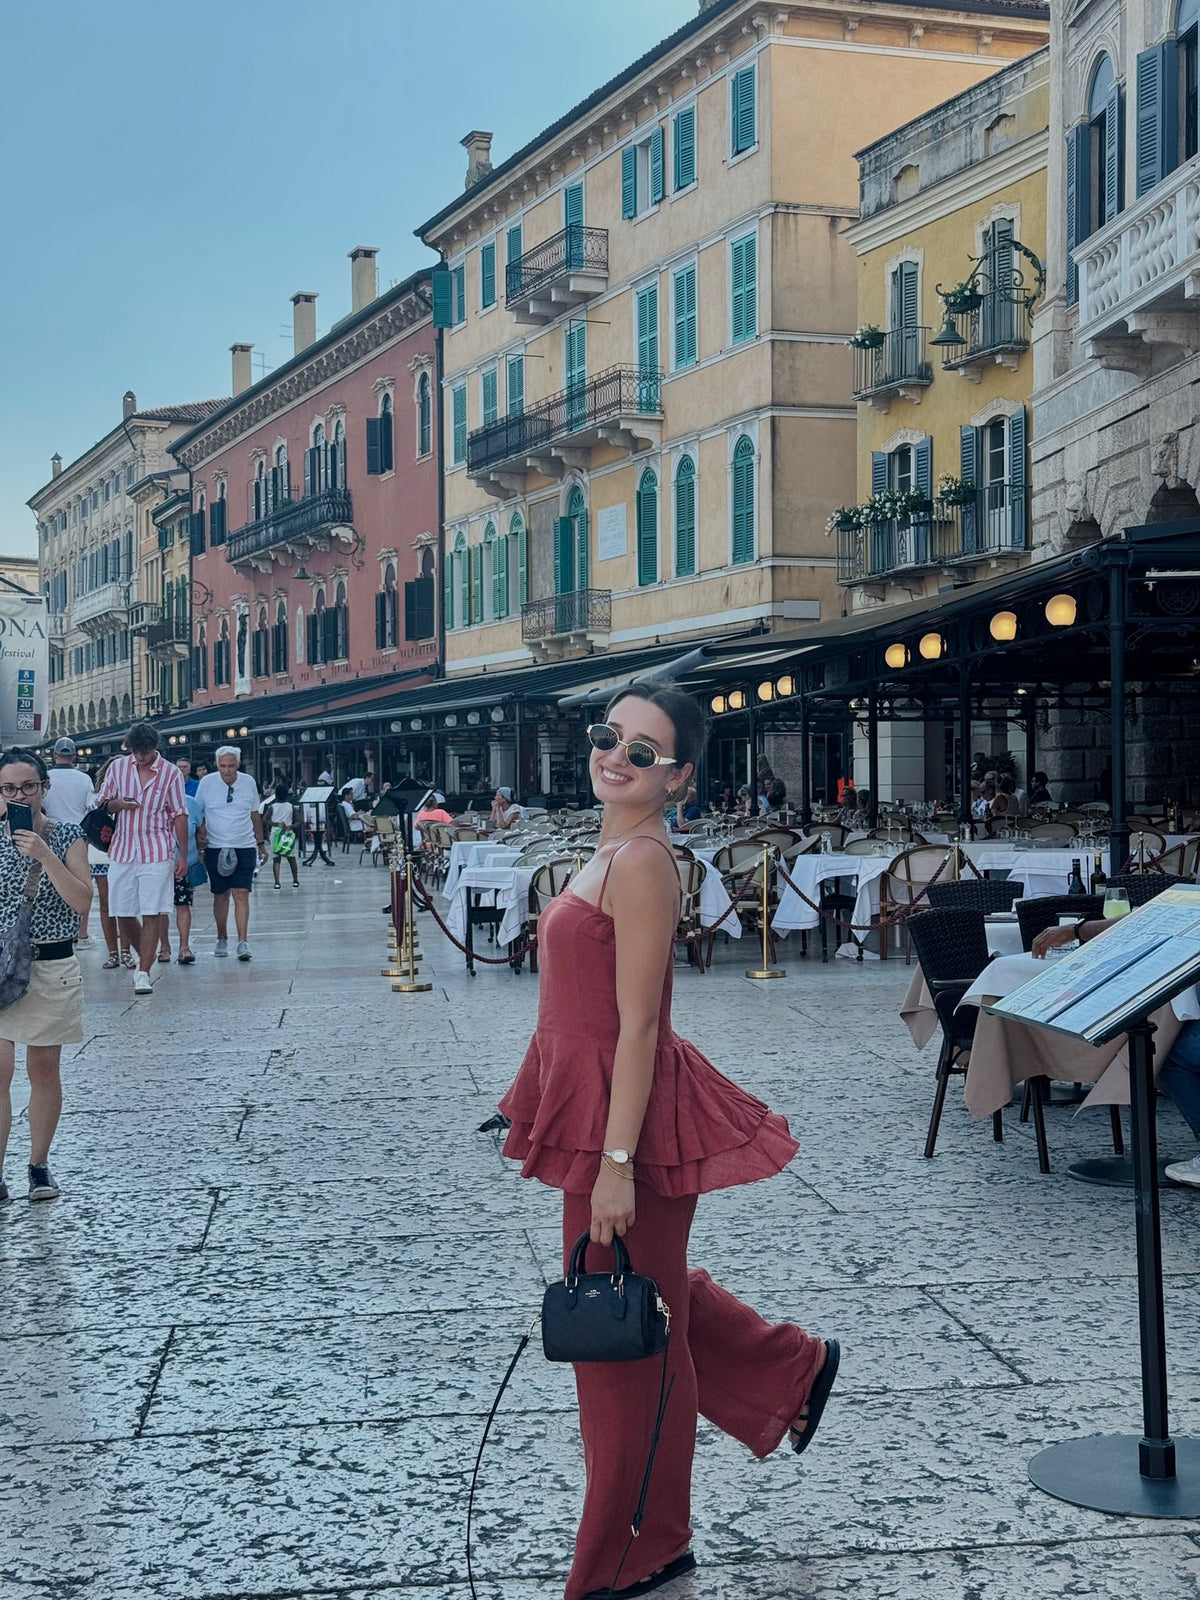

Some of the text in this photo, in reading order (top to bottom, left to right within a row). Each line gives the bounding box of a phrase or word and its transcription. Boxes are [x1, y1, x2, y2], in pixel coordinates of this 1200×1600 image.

[0, 647, 35, 660] festival
[24, 670, 29, 679] 8
[23, 685, 29, 693] 5
[20, 699, 31, 708] 20
